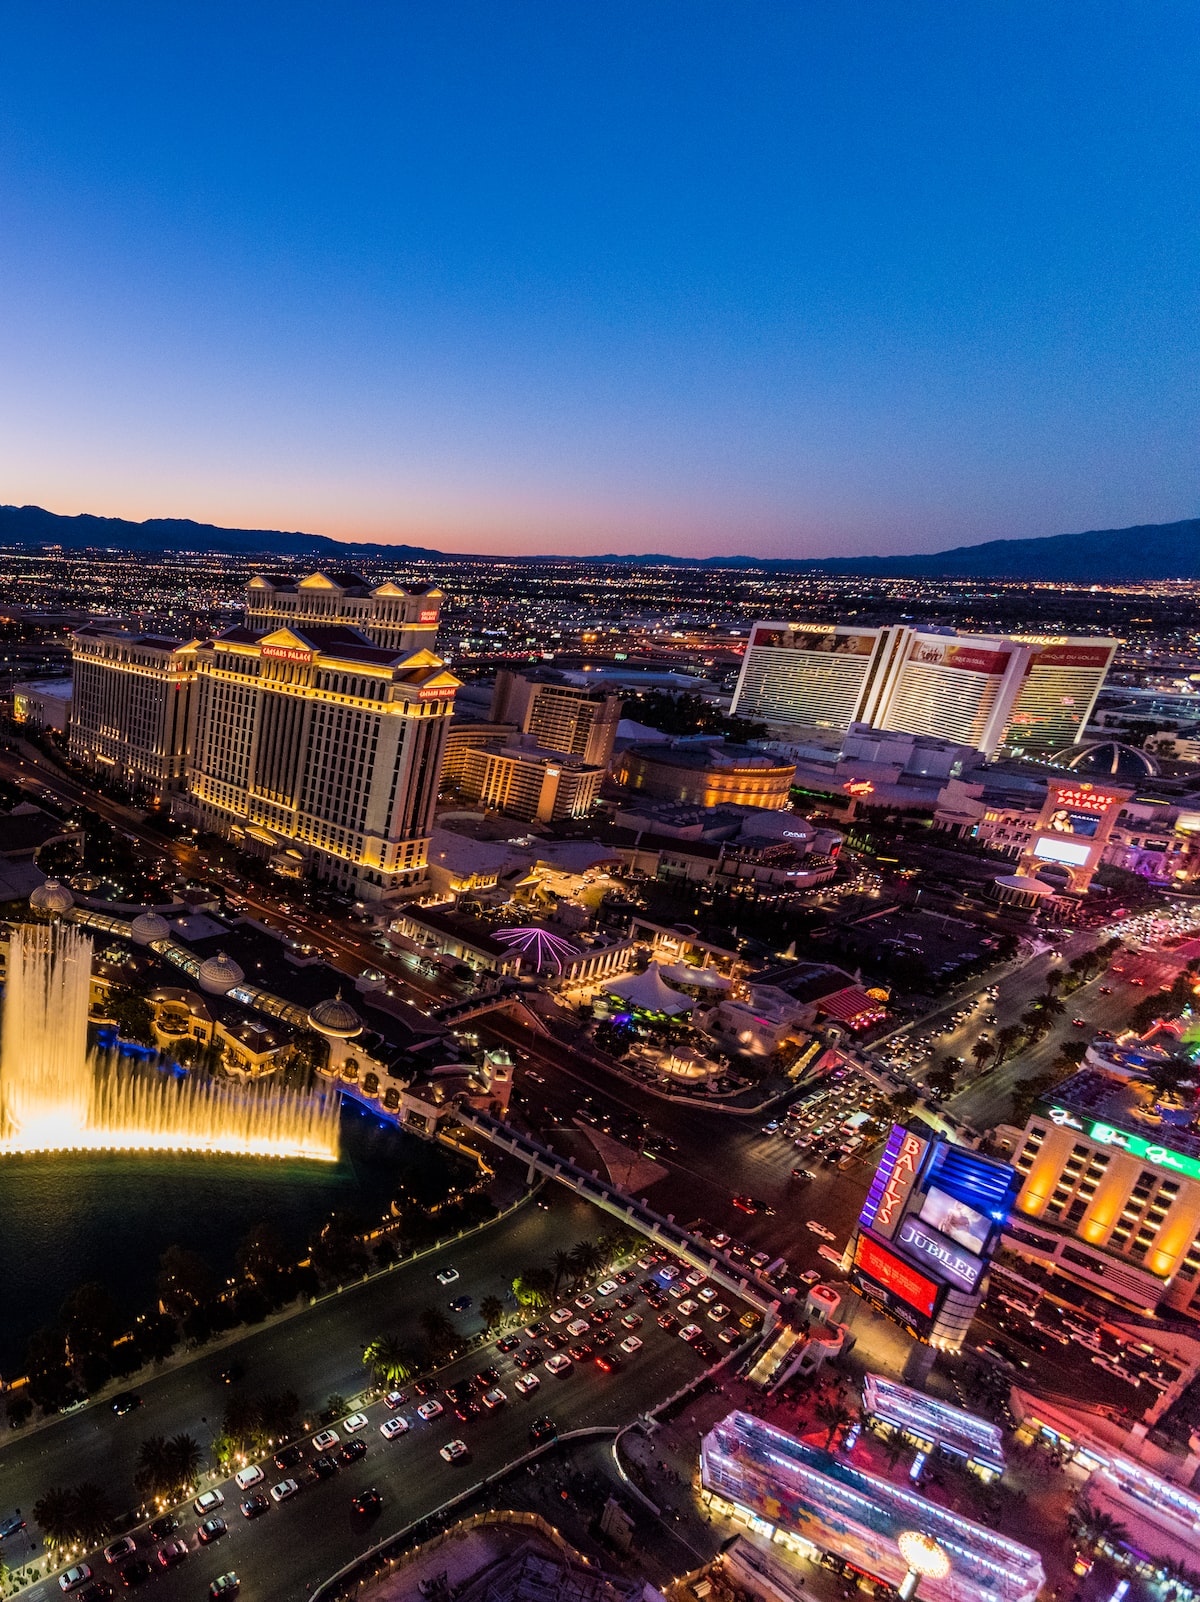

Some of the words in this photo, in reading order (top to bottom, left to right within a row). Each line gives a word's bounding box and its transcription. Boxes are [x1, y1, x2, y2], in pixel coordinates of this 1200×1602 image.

[796, 623, 836, 634] MIRAGE
[1018, 635, 1068, 645] MIRAGE
[263, 647, 287, 658] CAESARS
[287, 651, 311, 661] PALACE
[1057, 789, 1114, 804] CAESARS
[1057, 797, 1108, 811] PALACE
